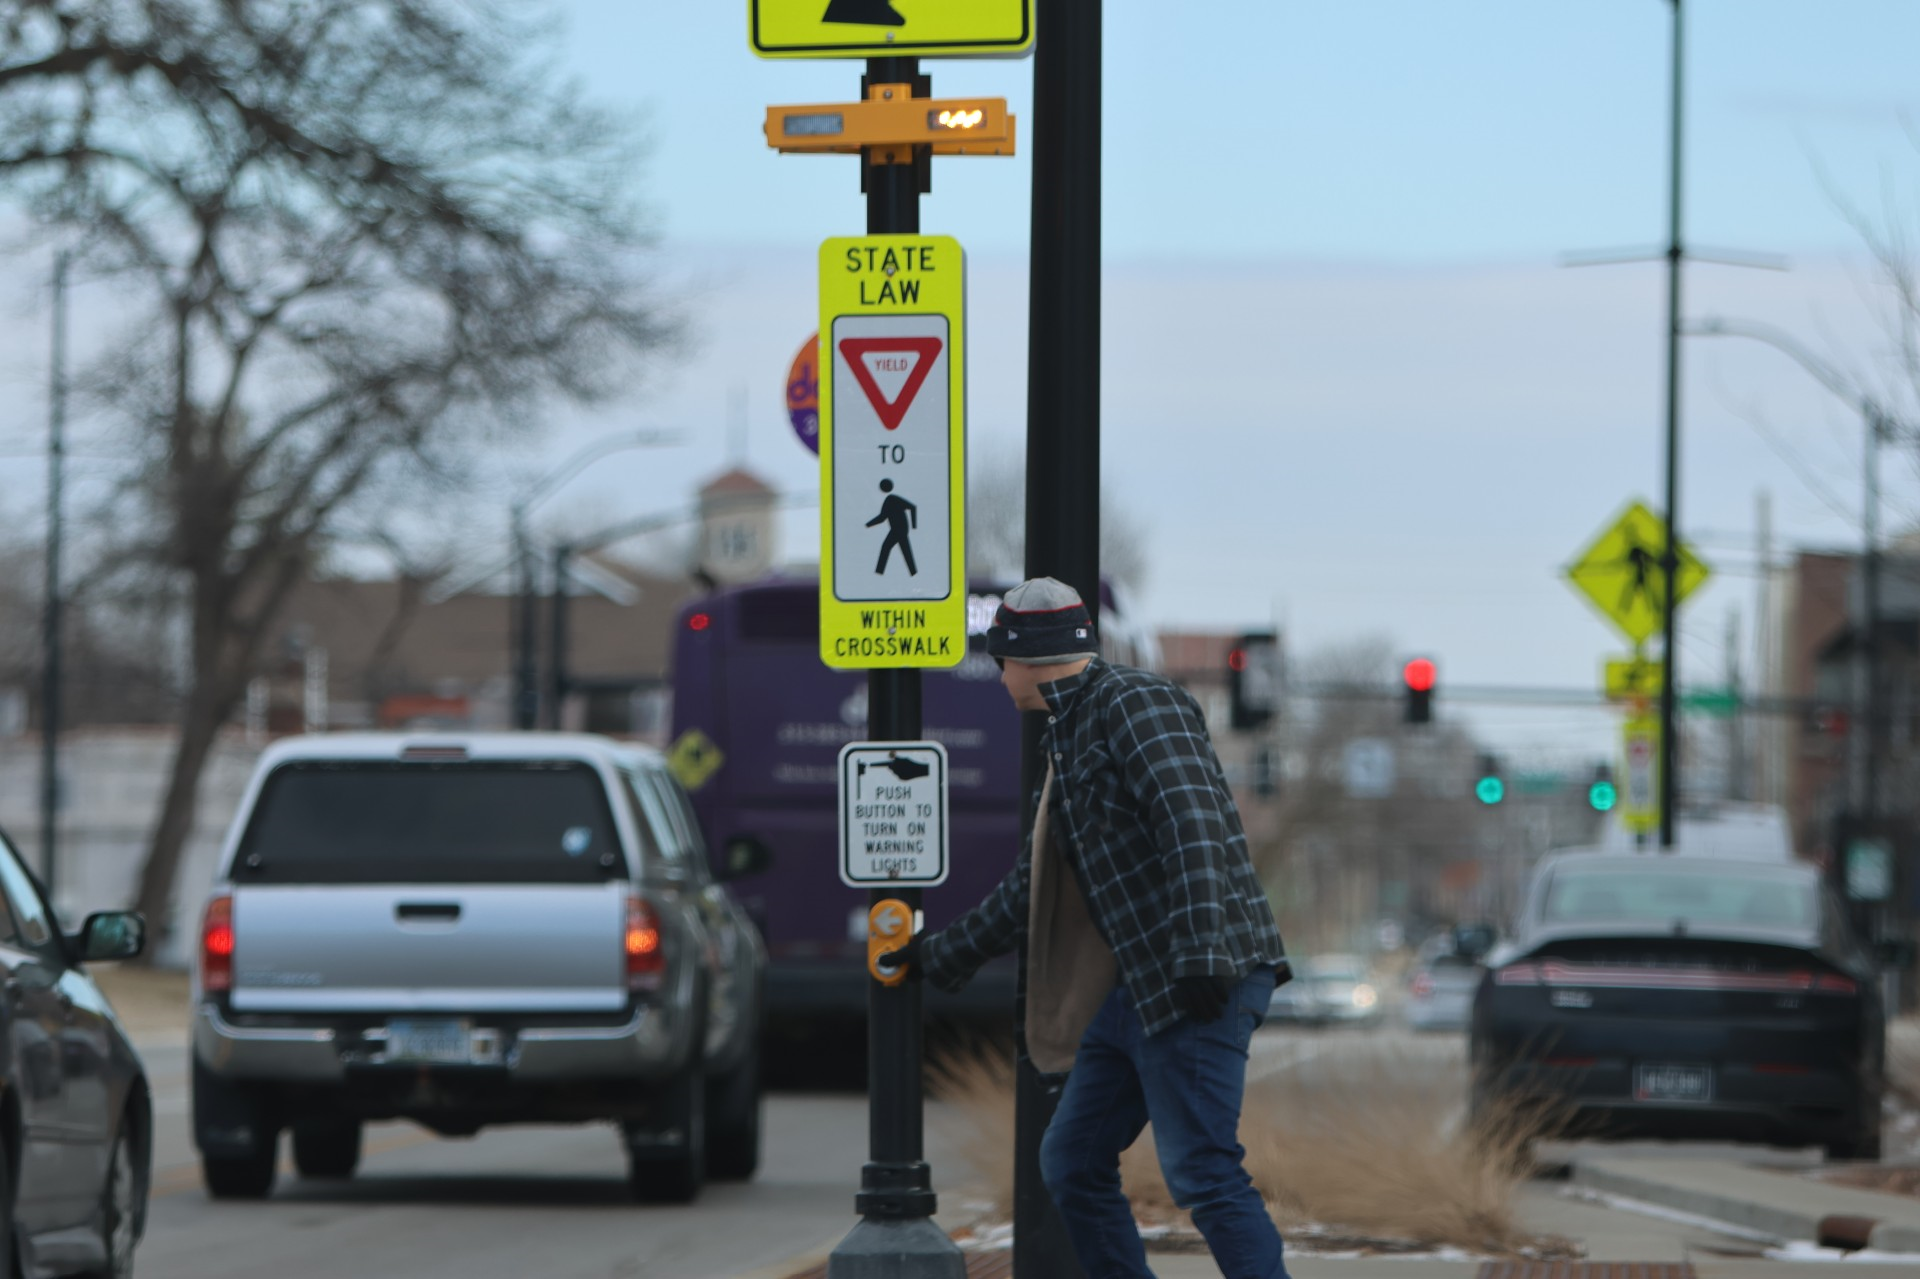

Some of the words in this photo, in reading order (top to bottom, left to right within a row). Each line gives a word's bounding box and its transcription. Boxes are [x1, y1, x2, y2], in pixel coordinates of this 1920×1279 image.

[846, 246, 935, 273] STATE
[860, 280, 920, 305] LAW
[874, 358, 908, 371] YIELD
[878, 444, 905, 464] TO
[861, 610, 926, 629] WITHIN
[835, 637, 950, 656] CROSSWALK
[875, 786, 911, 800] PUSH
[855, 804, 905, 818] BUTTON
[916, 803, 932, 817] TO
[863, 822, 897, 836] TURN
[907, 822, 925, 835] ON
[865, 840, 924, 854] WARNING
[871, 858, 917, 873] LIGHTS
